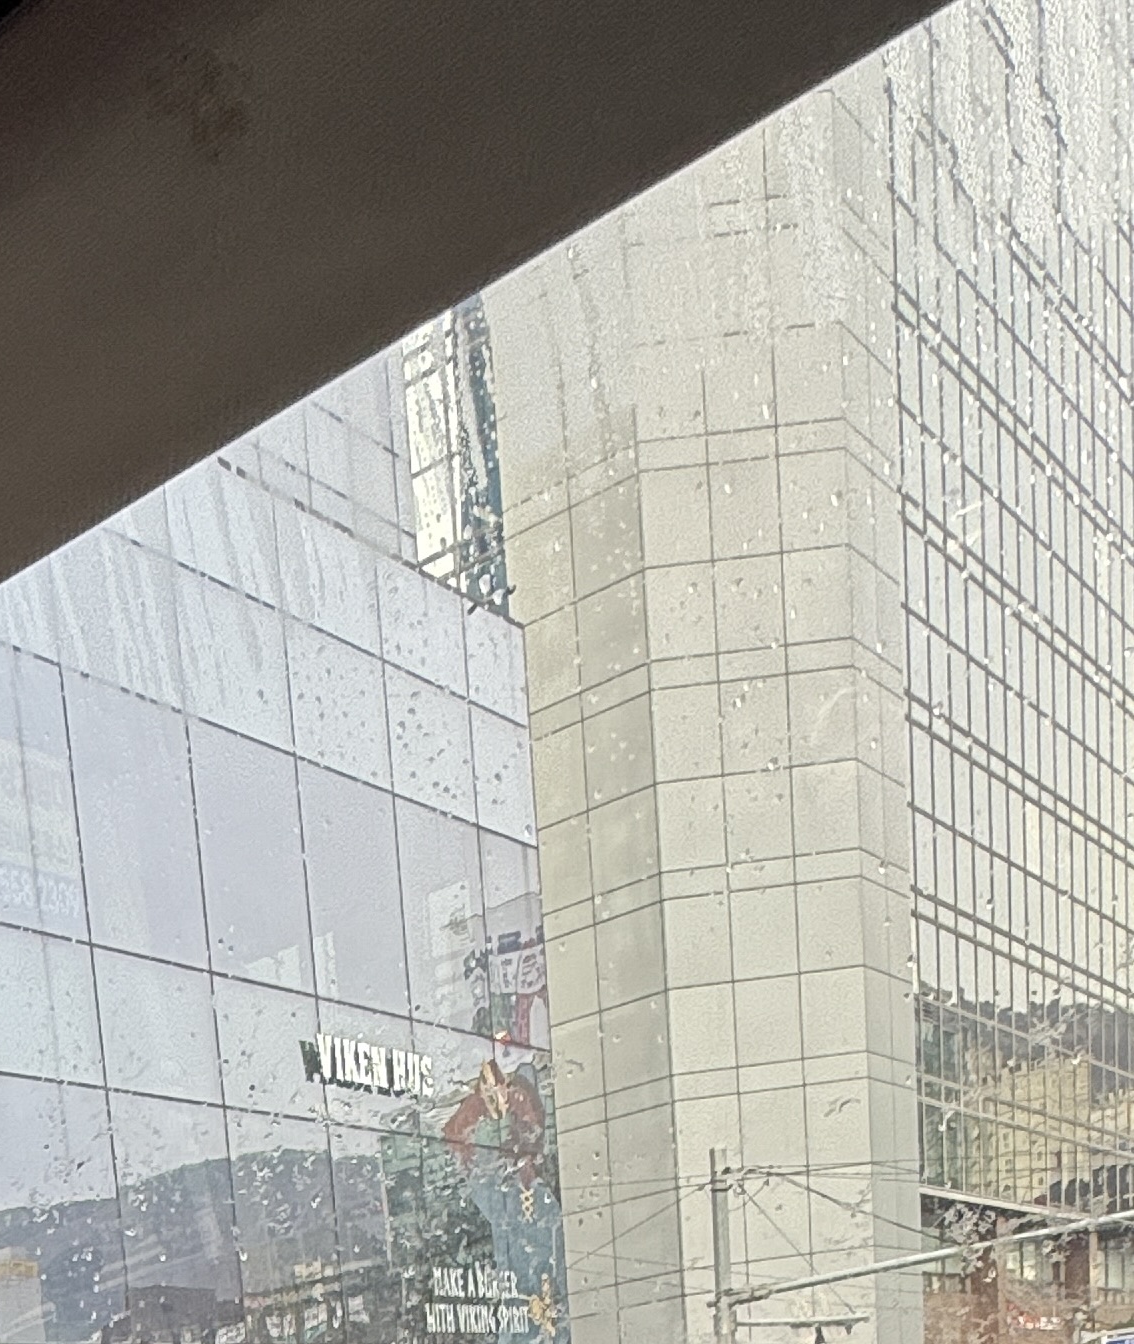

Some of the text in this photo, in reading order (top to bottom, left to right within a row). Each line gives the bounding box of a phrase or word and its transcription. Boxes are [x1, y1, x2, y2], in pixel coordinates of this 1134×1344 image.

[316, 1033, 434, 1098] VIKEN HUS
[432, 1266, 465, 1297] MAKE
[467, 1267, 476, 1297] A
[425, 1302, 529, 1334] WITH VIKING SPIRIT
